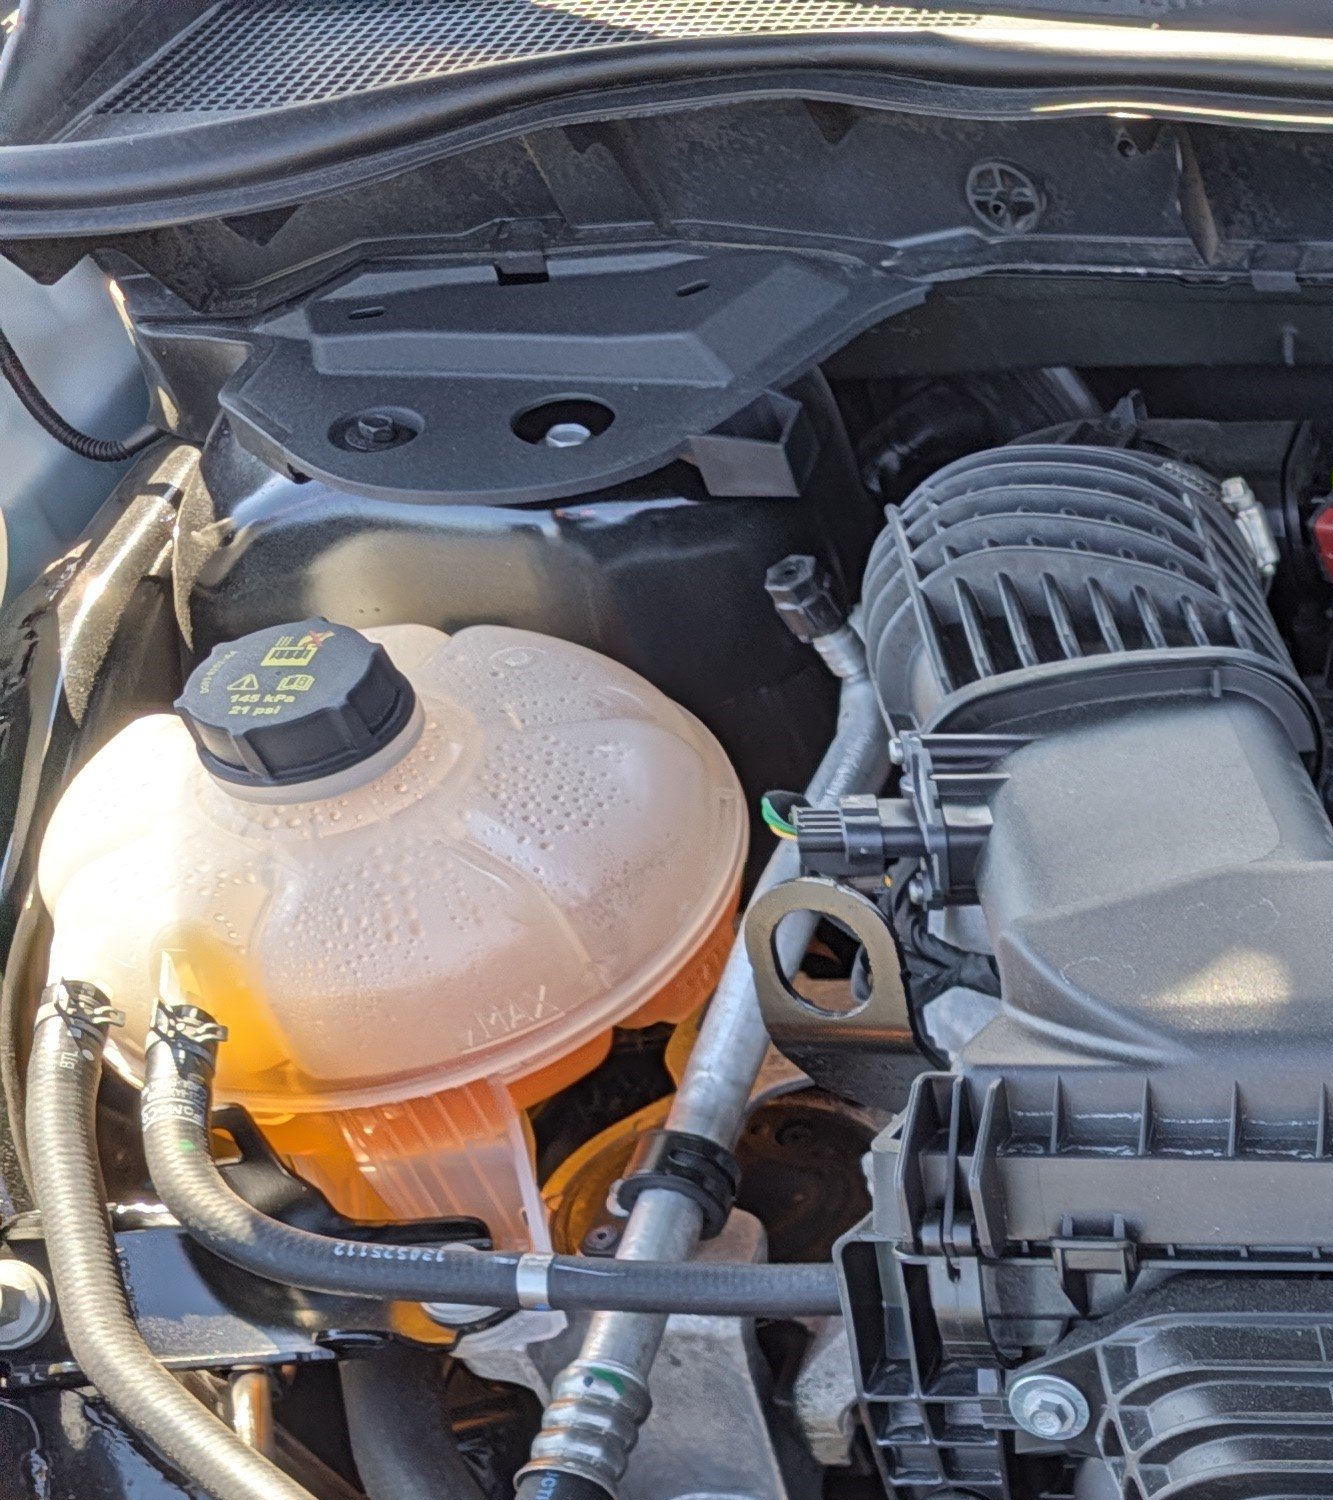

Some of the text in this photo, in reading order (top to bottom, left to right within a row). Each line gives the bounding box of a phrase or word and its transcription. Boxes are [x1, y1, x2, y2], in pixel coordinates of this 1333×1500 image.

[231, 694, 295, 703] 145 kPa
[228, 705, 281, 716] 21 psi
